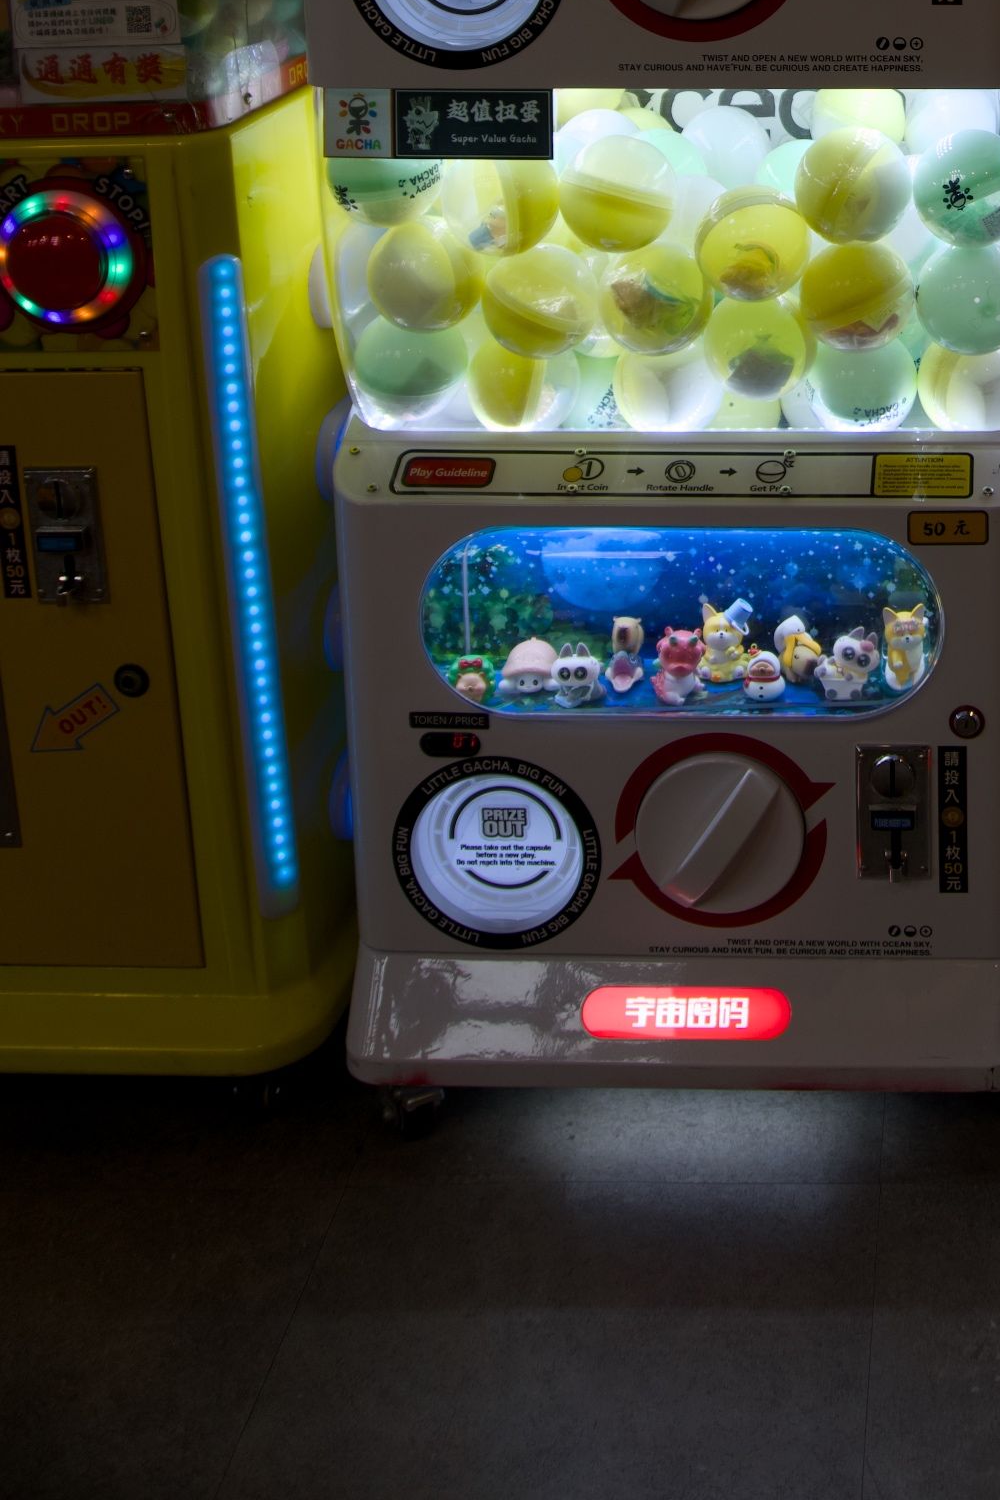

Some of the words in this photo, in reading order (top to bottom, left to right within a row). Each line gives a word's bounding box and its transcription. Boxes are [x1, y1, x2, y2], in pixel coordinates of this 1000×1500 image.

[702, 54, 728, 63] TWIST
[731, 54, 750, 63] AND
[752, 54, 777, 63] OPEN
[779, 54, 786, 63] A
[787, 54, 807, 63] NEW
[810, 54, 843, 63] WORLD
[845, 54, 867, 63] WITH
[869, 54, 901, 63] OCEAN
[903, 54, 923, 63] SKY,
[446, 98, 541, 124] 超值扭蛋
[52, 112, 131, 132] DROP
[336, 138, 381, 150] GACHA
[451, 134, 478, 146] Super
[481, 133, 508, 143] Value
[510, 133, 537, 144] Gacha
[96, 177, 150, 231] STOP!
[409, 467, 433, 479] Play
[435, 467, 488, 478] Guideline
[587, 483, 608, 491] Coin
[646, 484, 677, 492] Rotate
[680, 484, 714, 492] Handle
[924, 521, 945, 536] 50
[953, 520, 970, 536] 元
[59, 696, 108, 735] OUT!
[414, 715, 447, 725] TOKEN
[454, 716, 485, 726] PRICE
[422, 766, 460, 795] LITTLE
[517, 764, 539, 780] BIG
[541, 773, 567, 797] FUN
[483, 808, 526, 821] PRIZE
[483, 820, 526, 838] OUT
[625, 997, 750, 1029] 宇宙密码
